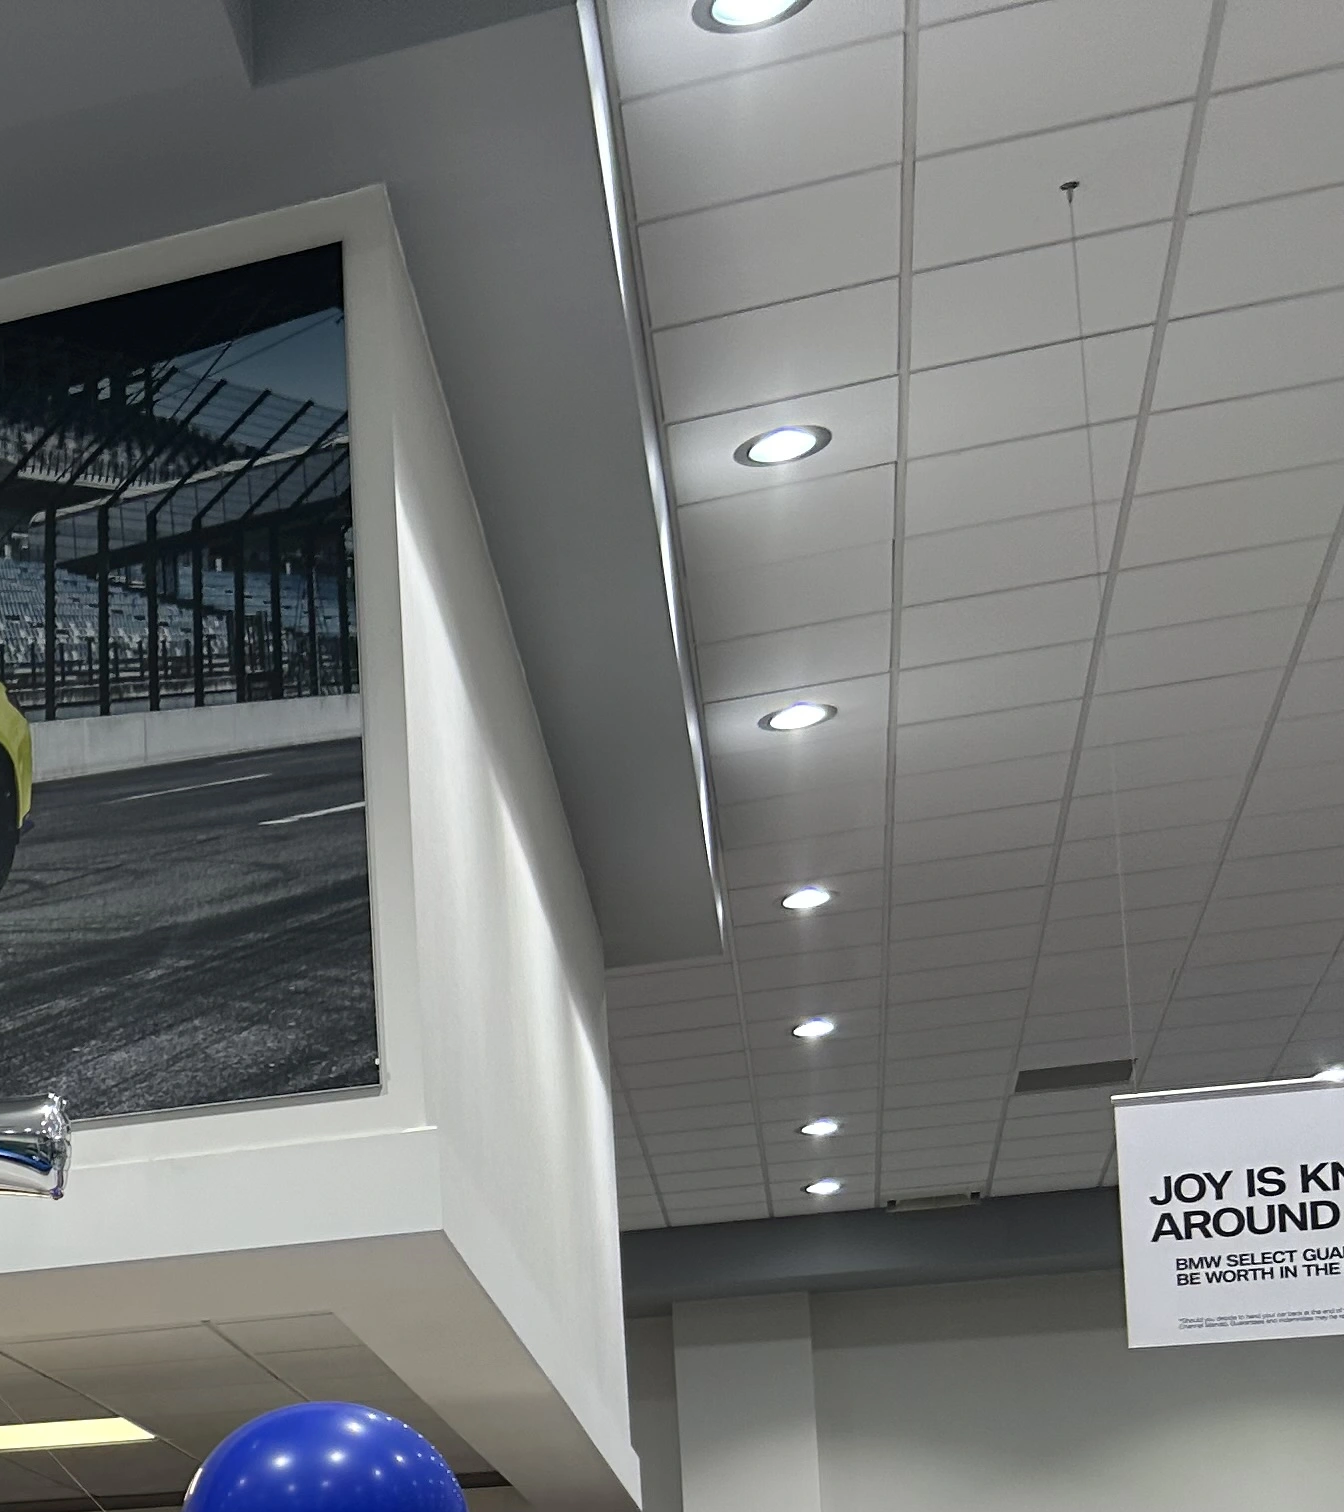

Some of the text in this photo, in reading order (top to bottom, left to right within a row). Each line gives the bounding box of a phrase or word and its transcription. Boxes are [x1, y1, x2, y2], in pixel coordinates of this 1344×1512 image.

[1149, 1170, 1233, 1205] JOY
[1246, 1166, 1286, 1198] IS
[1150, 1200, 1340, 1243] AROUND
[1176, 1256, 1222, 1271] BMW
[1226, 1250, 1297, 1268] SELECT
[1176, 1262, 1341, 1287] BE WORTH IN THE
